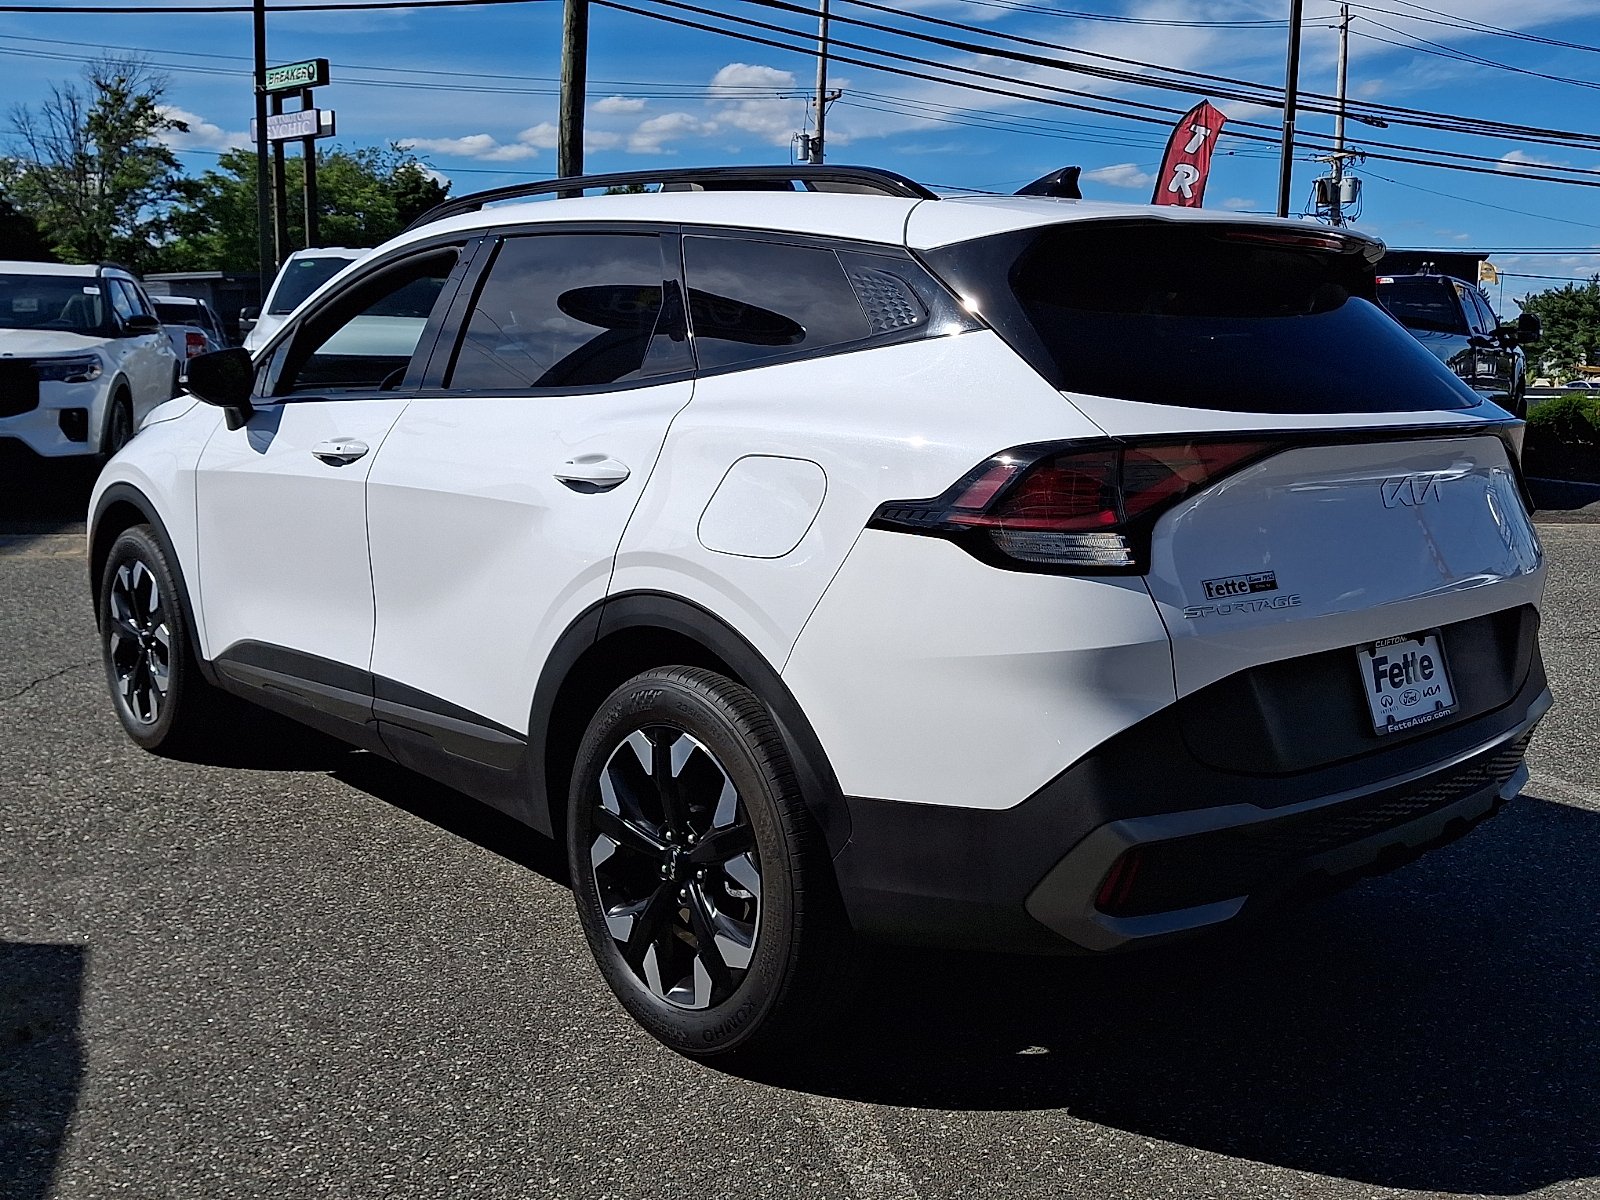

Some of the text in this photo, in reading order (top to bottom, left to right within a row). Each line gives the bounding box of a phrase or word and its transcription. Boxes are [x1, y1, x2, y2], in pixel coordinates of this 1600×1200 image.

[267, 120, 310, 138] SYCHIC
[1204, 579, 1248, 598] Fette
[1183, 594, 1302, 619] SPORTAGE
[1371, 651, 1435, 694] Fette
[1387, 708, 1452, 733] FetteAuto.com
